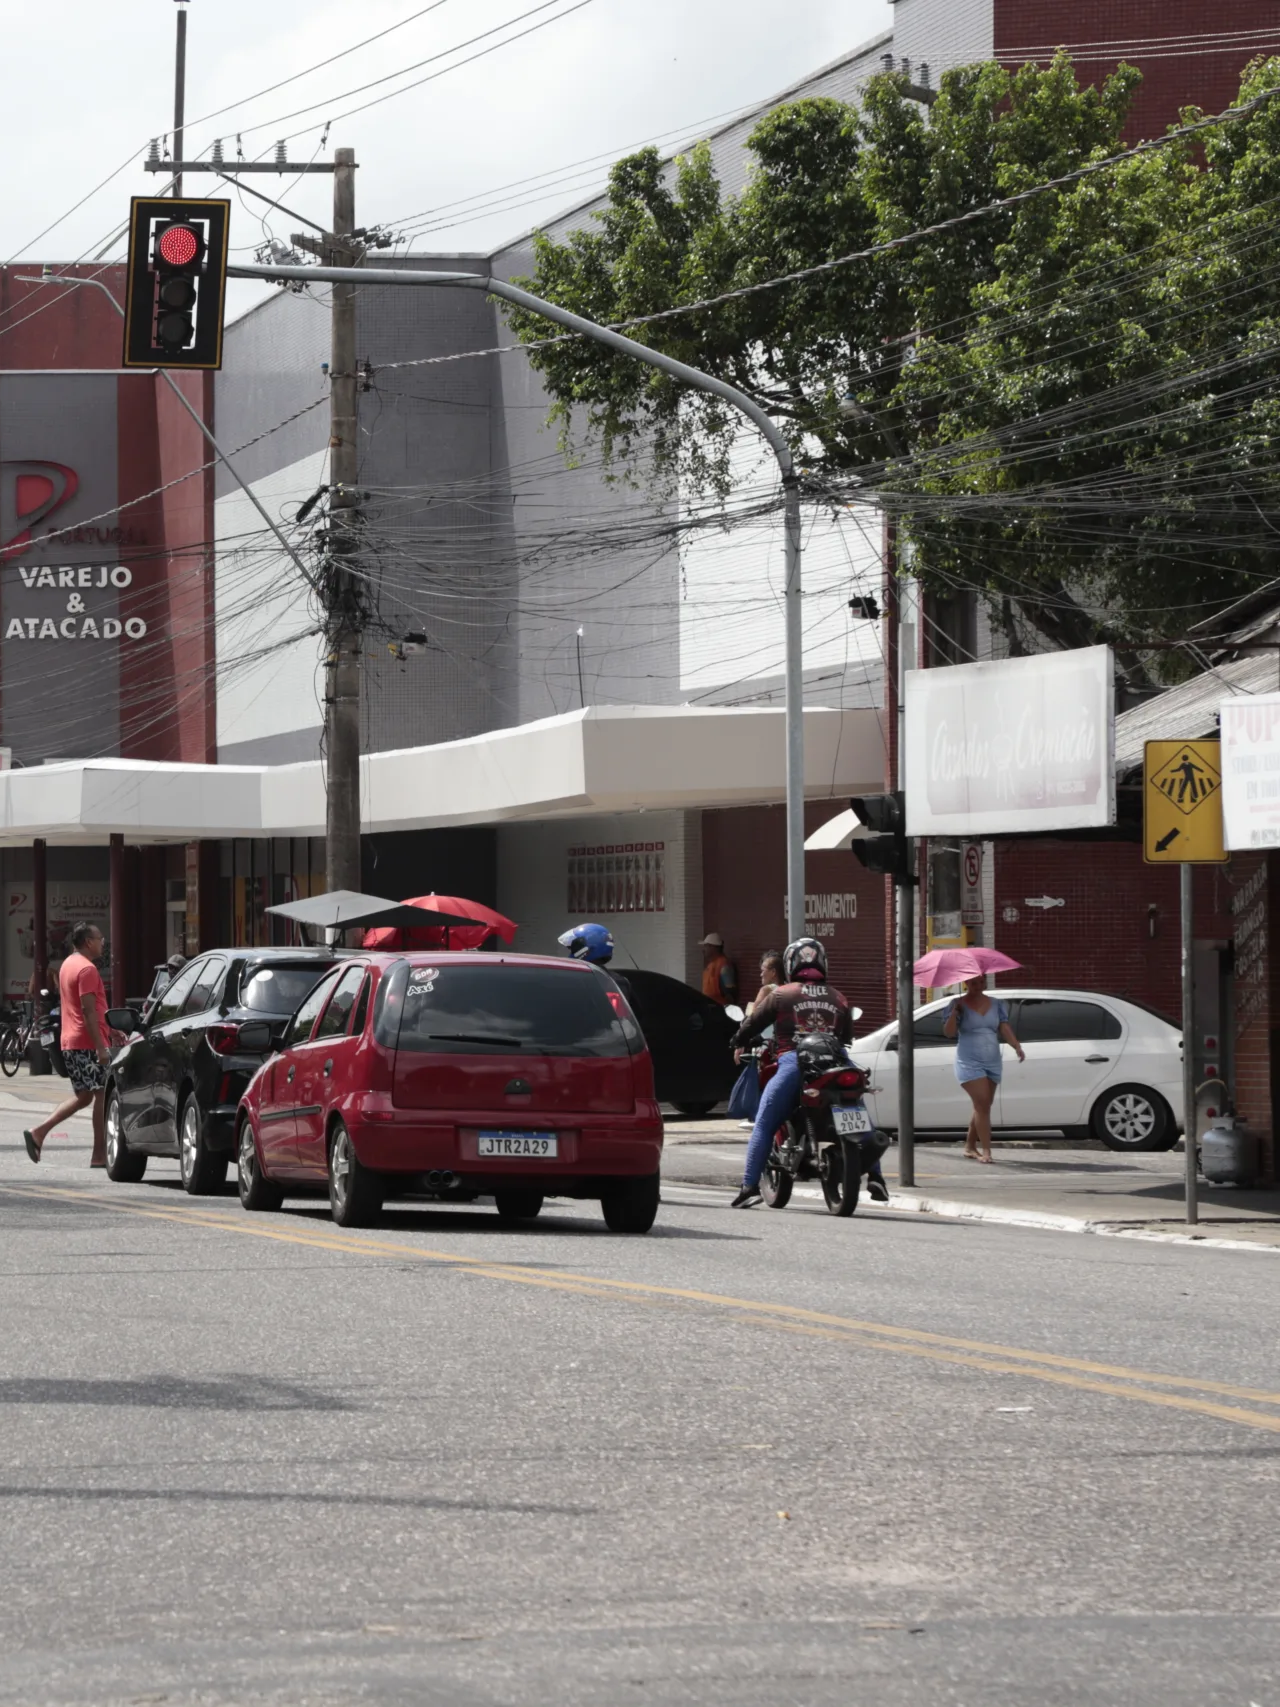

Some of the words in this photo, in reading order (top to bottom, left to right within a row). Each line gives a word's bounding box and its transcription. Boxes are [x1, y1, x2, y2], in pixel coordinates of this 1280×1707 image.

[18, 566, 132, 588] VAREJO
[66, 592, 86, 613] &
[5, 617, 147, 639] ATACADO
[50, 894, 110, 907] DELIVERY
[784, 893, 857, 919] ECIONAMENTO
[801, 984, 829, 997] ALICE
[793, 1000, 838, 1014] GUERREIRAS
[486, 1139, 549, 1154] JTR2A29
